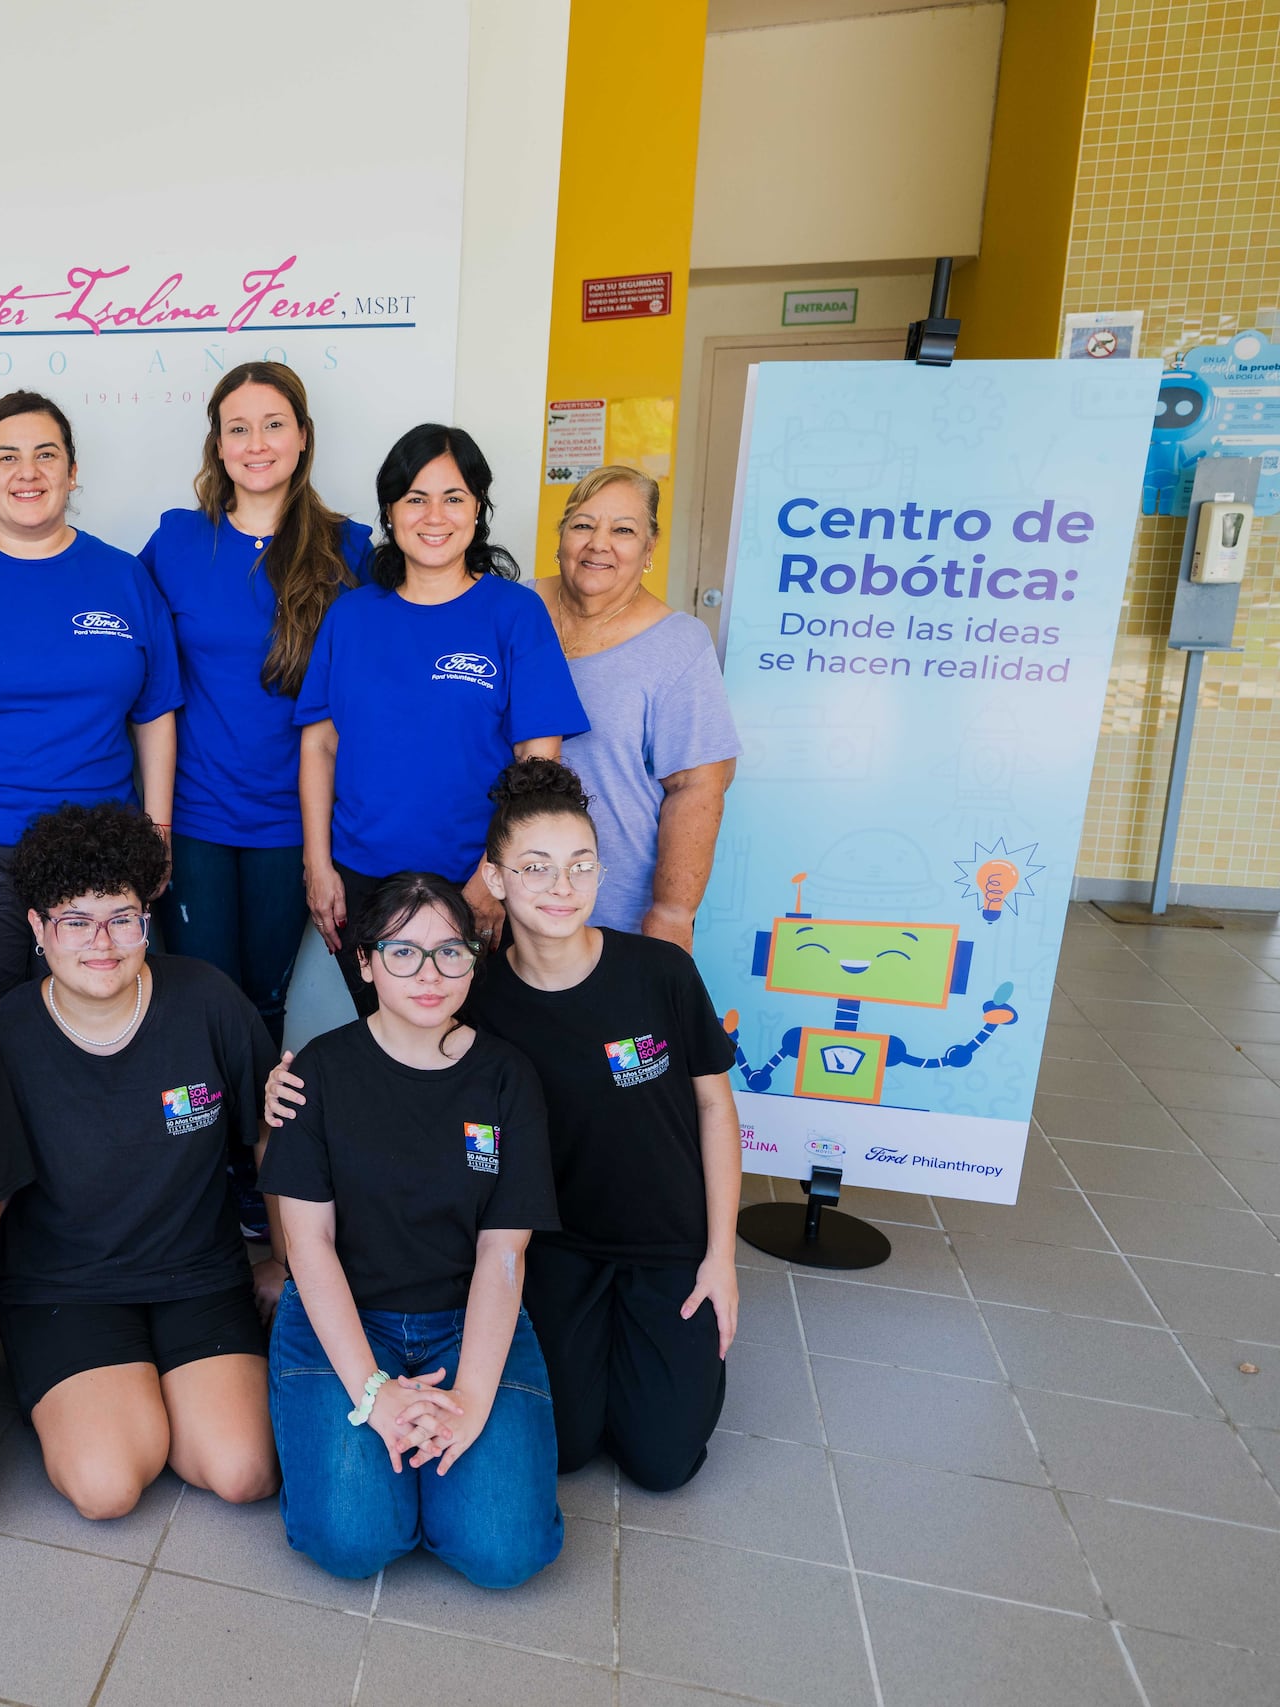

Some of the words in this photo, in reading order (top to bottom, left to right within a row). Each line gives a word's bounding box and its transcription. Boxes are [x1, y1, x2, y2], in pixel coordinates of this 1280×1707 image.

[606, 283, 617, 291] SU
[55, 265, 220, 336] Isolina
[354, 296, 416, 315] MSBT
[599, 305, 615, 313] ESTA
[794, 302, 849, 313] ENTRADA
[85, 391, 206, 404] 1914-201
[553, 401, 601, 409] ADVERTENCIA
[778, 498, 992, 542] Centro
[1012, 499, 1095, 543] de
[778, 553, 1079, 601] Robótica:
[83, 614, 120, 628] Ford
[780, 612, 895, 639] Donde
[906, 616, 954, 641] las
[964, 617, 1060, 645] ideas
[445, 656, 487, 673] Ford
[758, 652, 795, 671] se
[805, 648, 911, 676] hacen
[923, 654, 1071, 683] realidad
[446, 674, 477, 683] Volunteer
[477, 679, 494, 689] Corps
[636, 1038, 654, 1051] SOR
[639, 1040, 667, 1059] ISOLINA
[638, 1064, 659, 1074] Creando
[616, 1075, 643, 1085] SISTEMA
[189, 1087, 208, 1098] SOR
[191, 1091, 222, 1107] ISOLINA
[168, 1124, 193, 1132] SISTEMA
[740, 1130, 754, 1139] OR
[740, 1140, 778, 1152] OLINA
[865, 1146, 908, 1165] Ford
[912, 1156, 1004, 1178] Philanthropy
